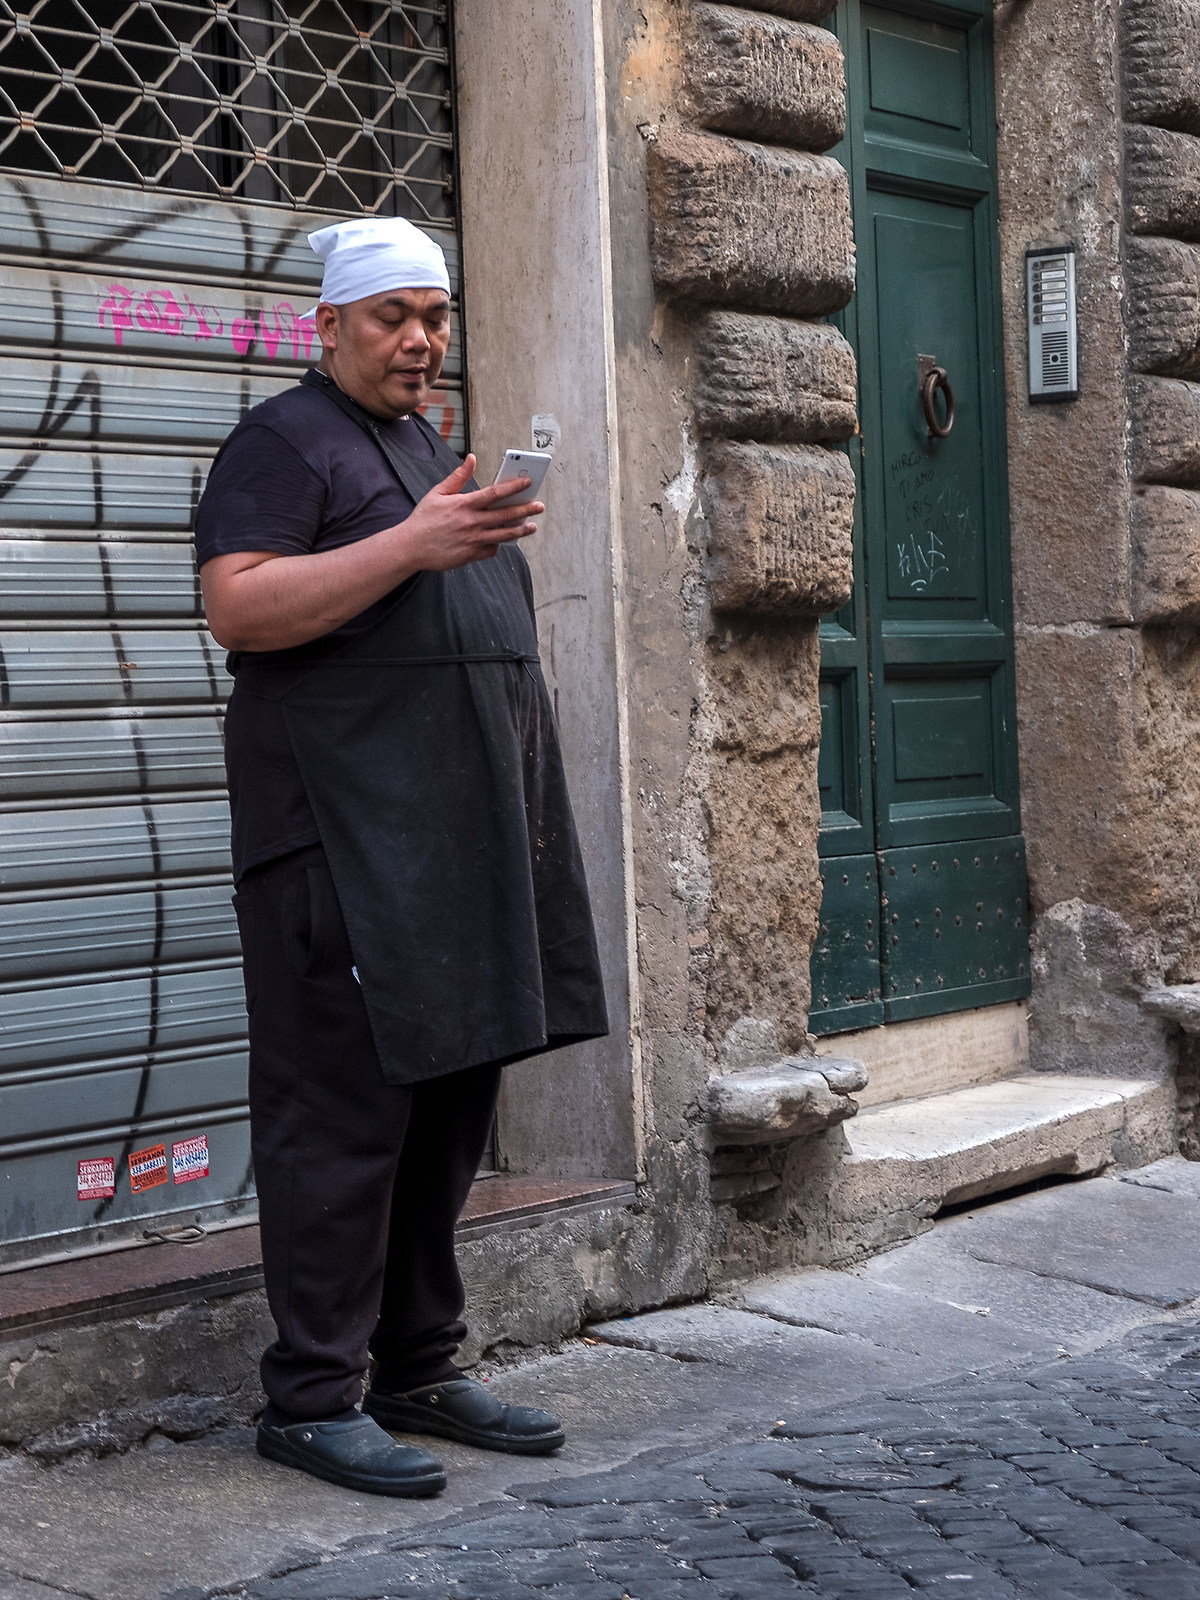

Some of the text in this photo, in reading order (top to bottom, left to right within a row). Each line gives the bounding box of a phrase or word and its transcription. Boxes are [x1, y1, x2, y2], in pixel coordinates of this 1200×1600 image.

[905, 494, 933, 522] CRIS
[130, 1149, 164, 1166] SERRANDE
[173, 1140, 207, 1158] SERRANDE
[80, 1162, 114, 1175] SERRANDE
